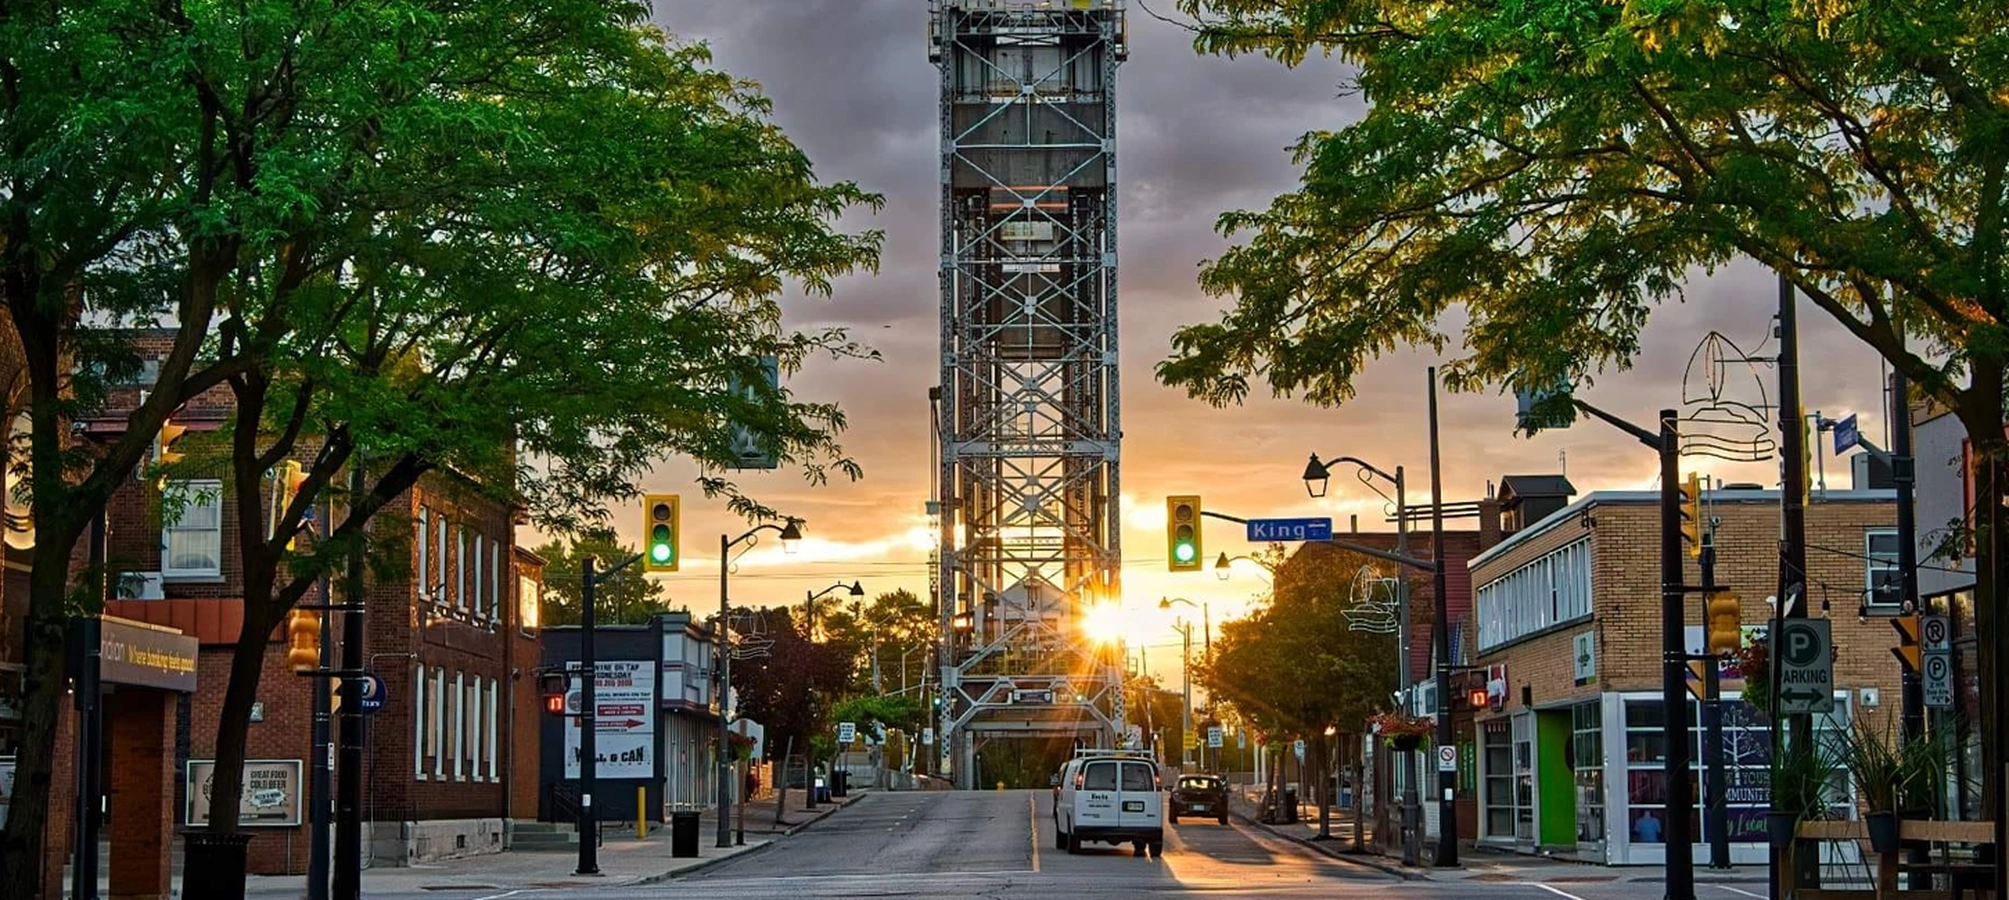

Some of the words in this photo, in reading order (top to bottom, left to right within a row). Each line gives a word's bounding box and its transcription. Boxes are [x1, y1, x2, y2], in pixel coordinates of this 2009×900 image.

[1253, 522, 1305, 540] King
[1789, 632, 1810, 658] P
[626, 663, 640, 671] TAP
[1933, 662, 1941, 676] P
[1783, 669, 1828, 684] ARKING
[551, 697, 562, 710] 17
[1473, 691, 1486, 705] 17
[250, 770, 269, 779] GREAT
[270, 770, 288, 779] FOOD
[269, 779, 286, 789] BEER
